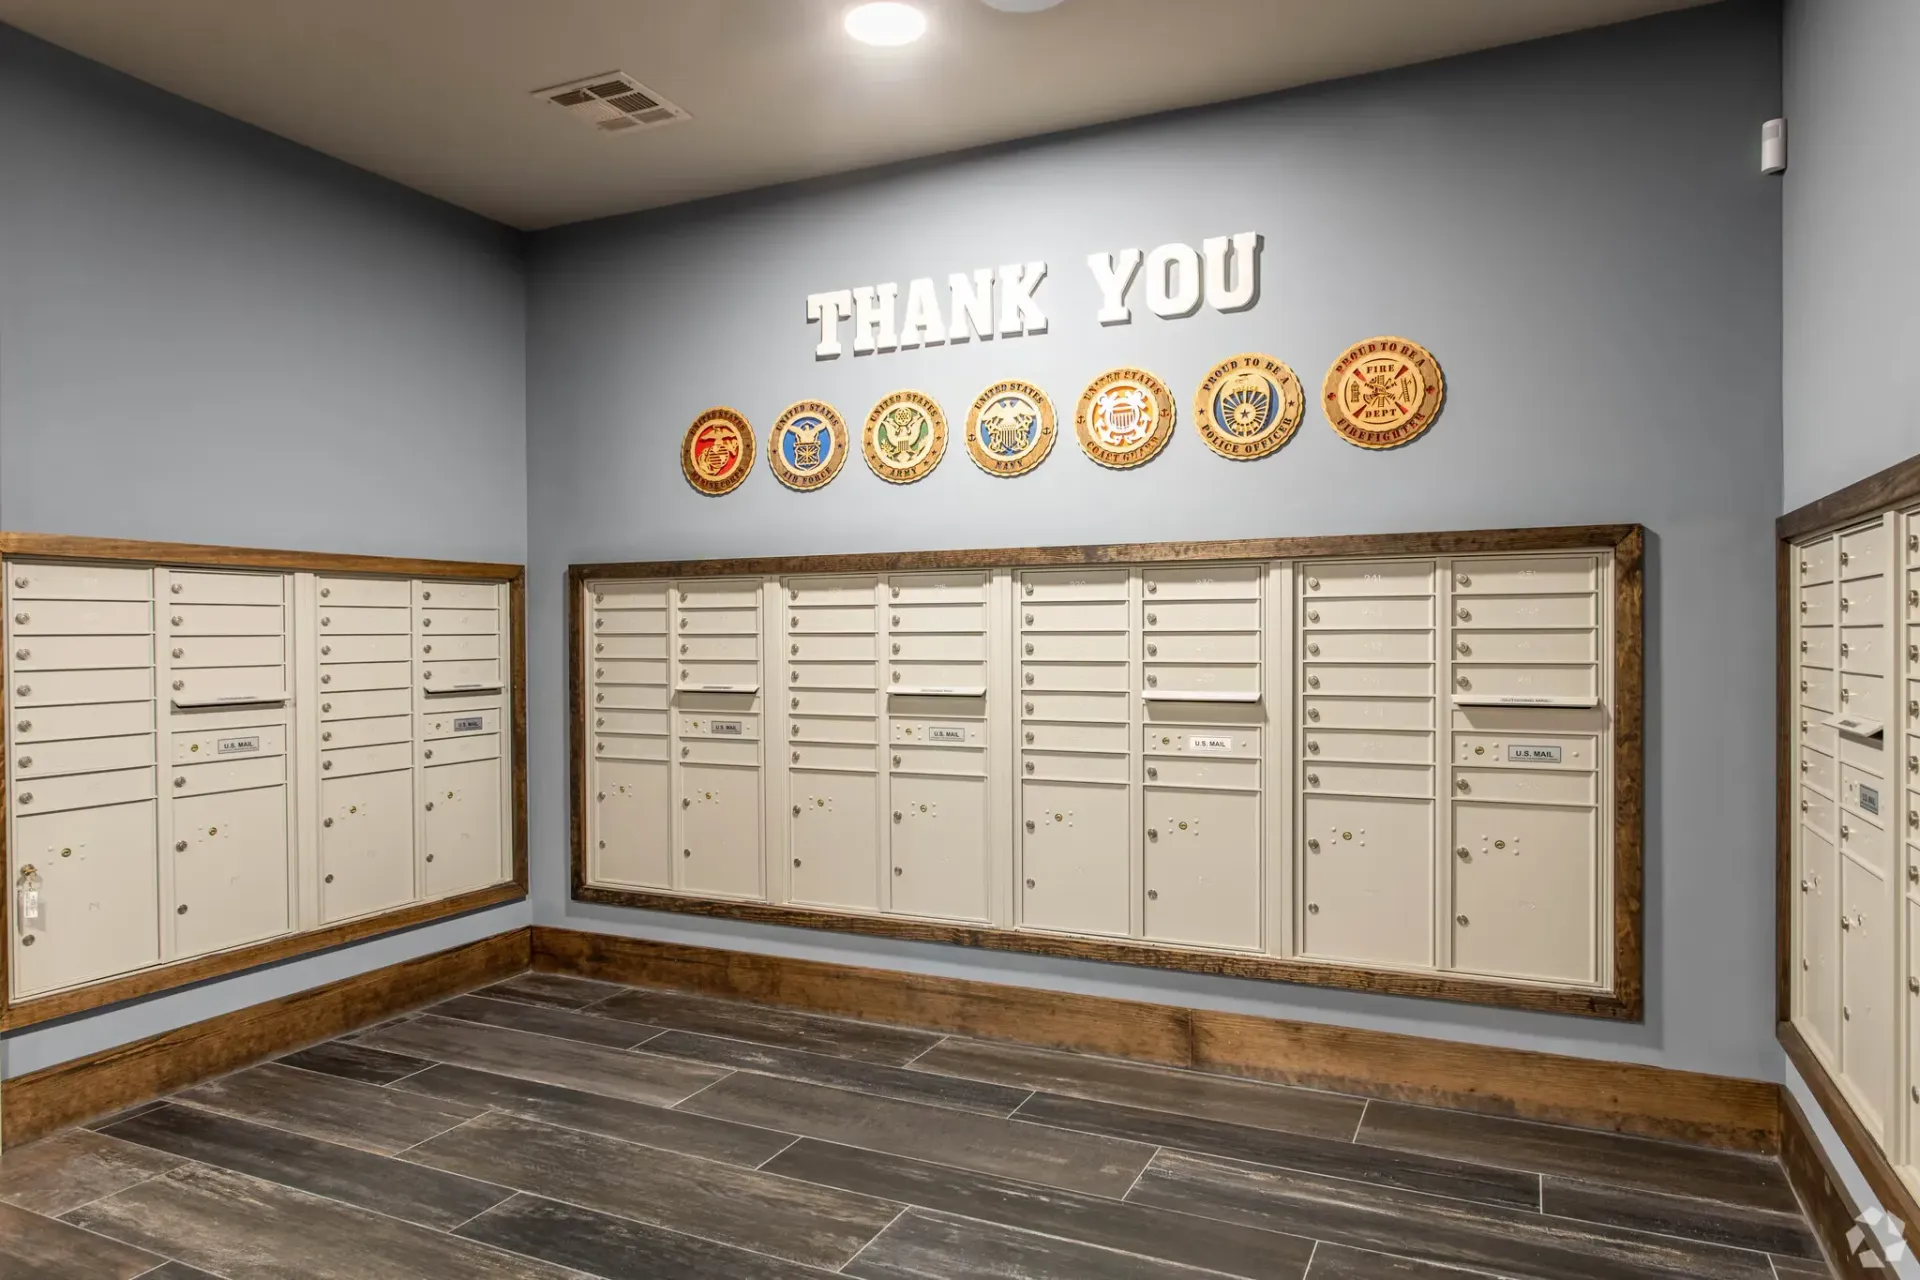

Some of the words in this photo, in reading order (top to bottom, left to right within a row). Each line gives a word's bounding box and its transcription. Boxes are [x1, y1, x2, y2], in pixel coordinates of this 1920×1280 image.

[807, 261, 1047, 360] THANK
[1087, 231, 1262, 327] YOU
[1336, 344, 1376, 374] PROUD
[1380, 342, 1397, 351] TO
[1400, 345, 1418, 360] BE
[1416, 358, 1426, 367] A
[1366, 364, 1394, 374] FIRE
[1083, 372, 1121, 401] UNITED
[1124, 371, 1162, 395] STATES
[1203, 361, 1238, 391] PROUD
[1244, 358, 1260, 367] TO
[1265, 361, 1281, 375] BE
[1280, 377, 1290, 385] A
[870, 395, 901, 422] UNITED
[906, 393, 938, 417] STATES
[974, 384, 1007, 410] UNITED
[1009, 383, 1044, 404] STATES
[690, 412, 717, 435] UNITED
[776, 404, 805, 431] UNITED
[809, 403, 839, 427] STATES
[1365, 409, 1397, 418] DEPT
[1202, 424, 1239, 453] POLICE
[1245, 418, 1292, 453] OFFICER
[1337, 413, 1425, 441] FIREFIGHTER
[1086, 441, 1120, 462] COAST
[783, 471, 797, 483] AIR
[802, 466, 831, 484] FORCE
[889, 467, 917, 477] ARMY
[994, 460, 1023, 470] NAVY
[720, 468, 744, 488] CORPS
[1209, 740, 1226, 748] MAIL
